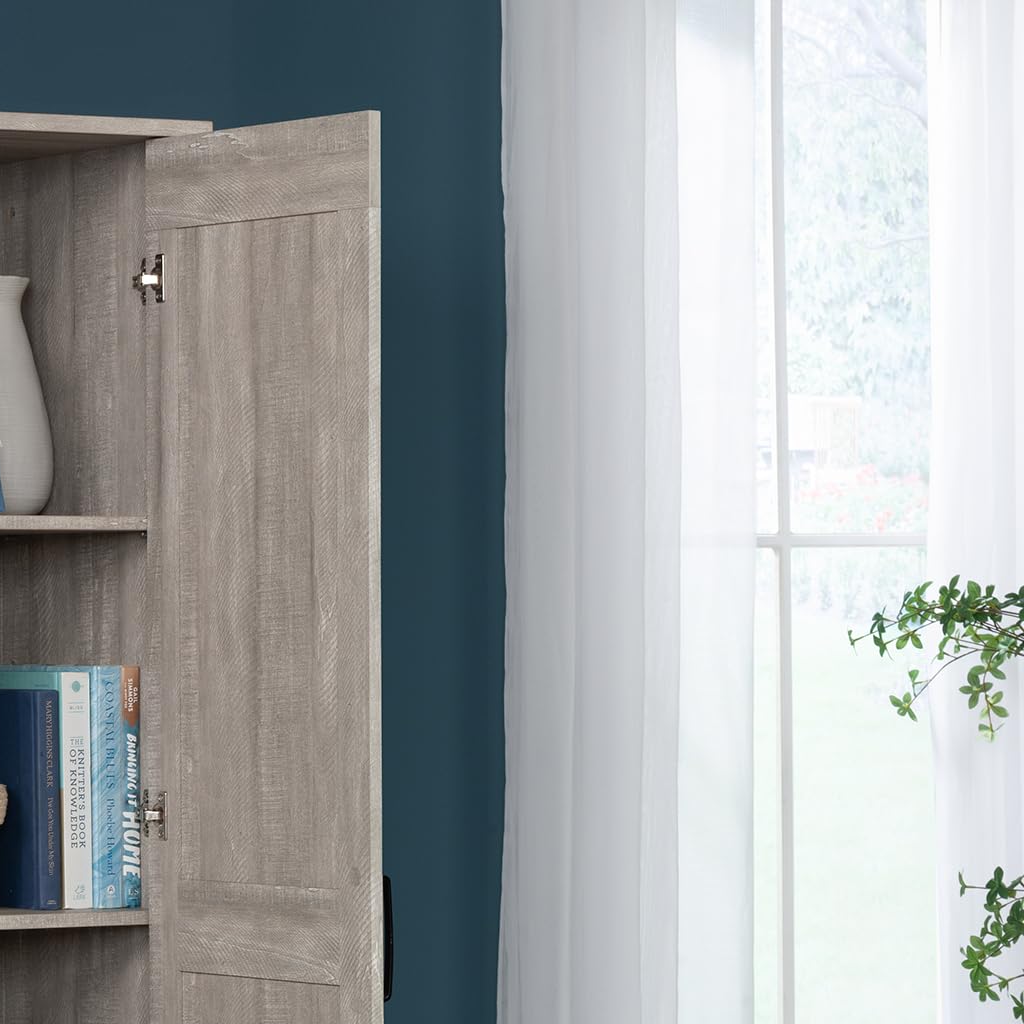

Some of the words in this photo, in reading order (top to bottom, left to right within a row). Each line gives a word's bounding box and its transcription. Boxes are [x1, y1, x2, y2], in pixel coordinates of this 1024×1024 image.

[45, 700, 53, 725] MARY
[106, 681, 115, 744] COASTAL
[69, 749, 76, 765] OF
[106, 748, 115, 789] BLUES
[126, 733, 137, 790] BRINGING
[70, 770, 78, 848] KNOWLEDGE
[106, 798, 115, 834] Phoebe
[127, 793, 137, 807] IT
[47, 850, 54, 860] My
[107, 837, 115, 876] Howard
[122, 811, 141, 878] HOME
